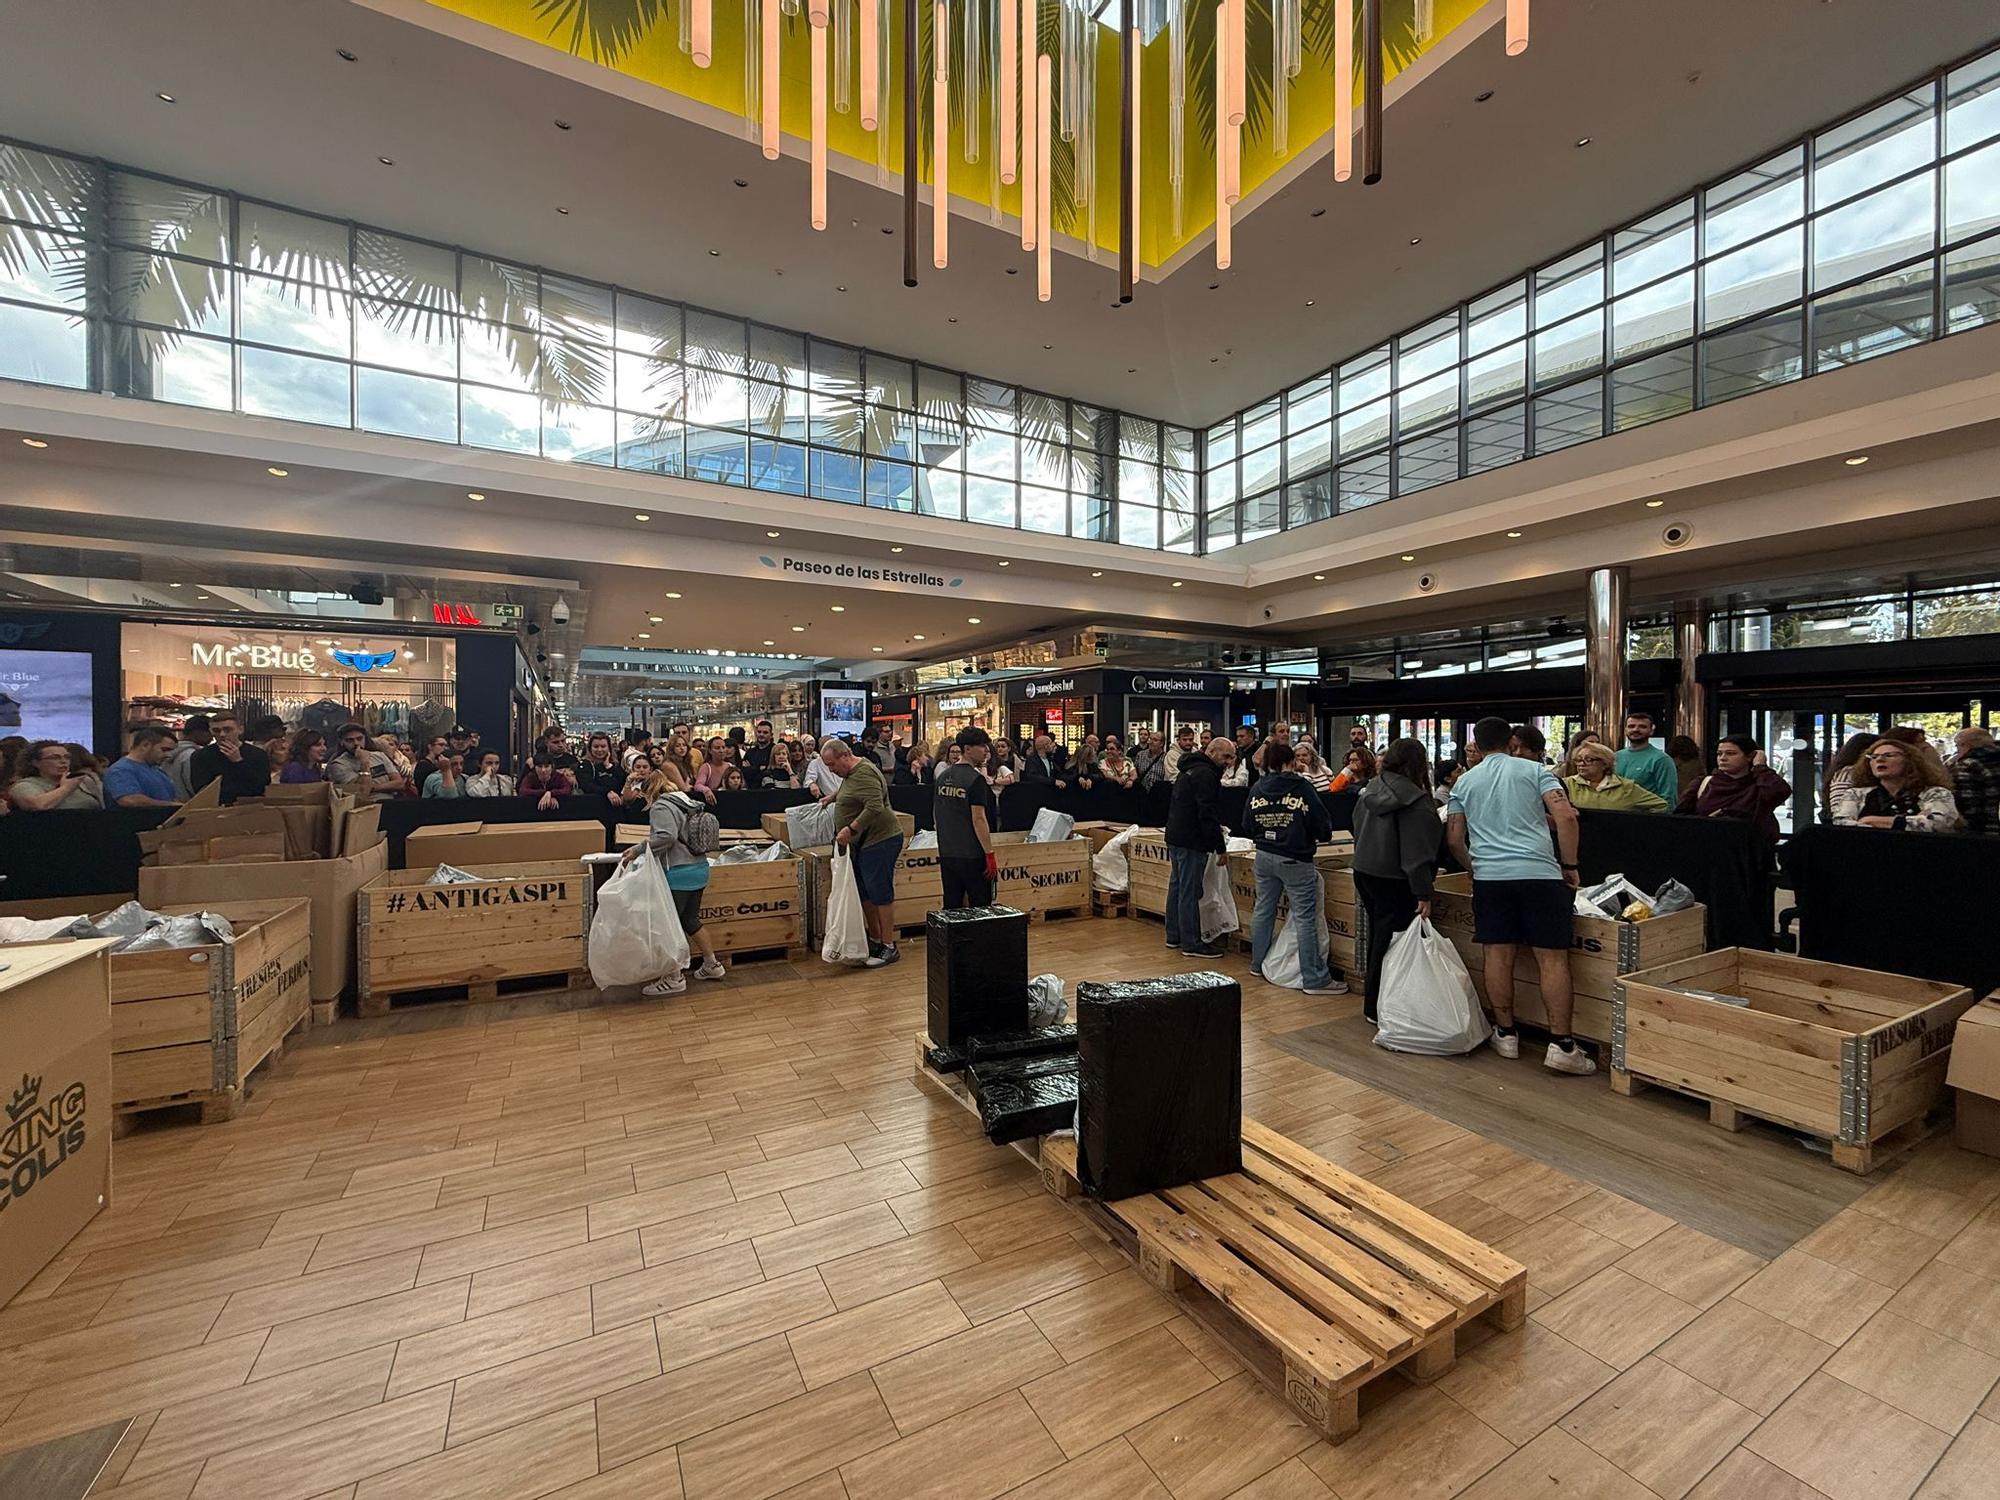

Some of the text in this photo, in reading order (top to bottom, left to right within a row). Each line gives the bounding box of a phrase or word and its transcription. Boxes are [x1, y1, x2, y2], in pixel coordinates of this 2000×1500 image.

[783, 558, 944, 587] Paseo de las Estrellas
[192, 643, 316, 669] Mr. Blue
[13, 672, 40, 682] Blue
[1148, 678, 1204, 692] sunglass hut
[1035, 679, 1074, 696] sunglass hut
[1135, 842, 1170, 862] #ANTI
[906, 855, 940, 869] COLI
[999, 866, 1081, 888] OCK SECRET
[386, 882, 568, 913] #ANTIGASPI
[700, 900, 790, 919] ING COLIS
